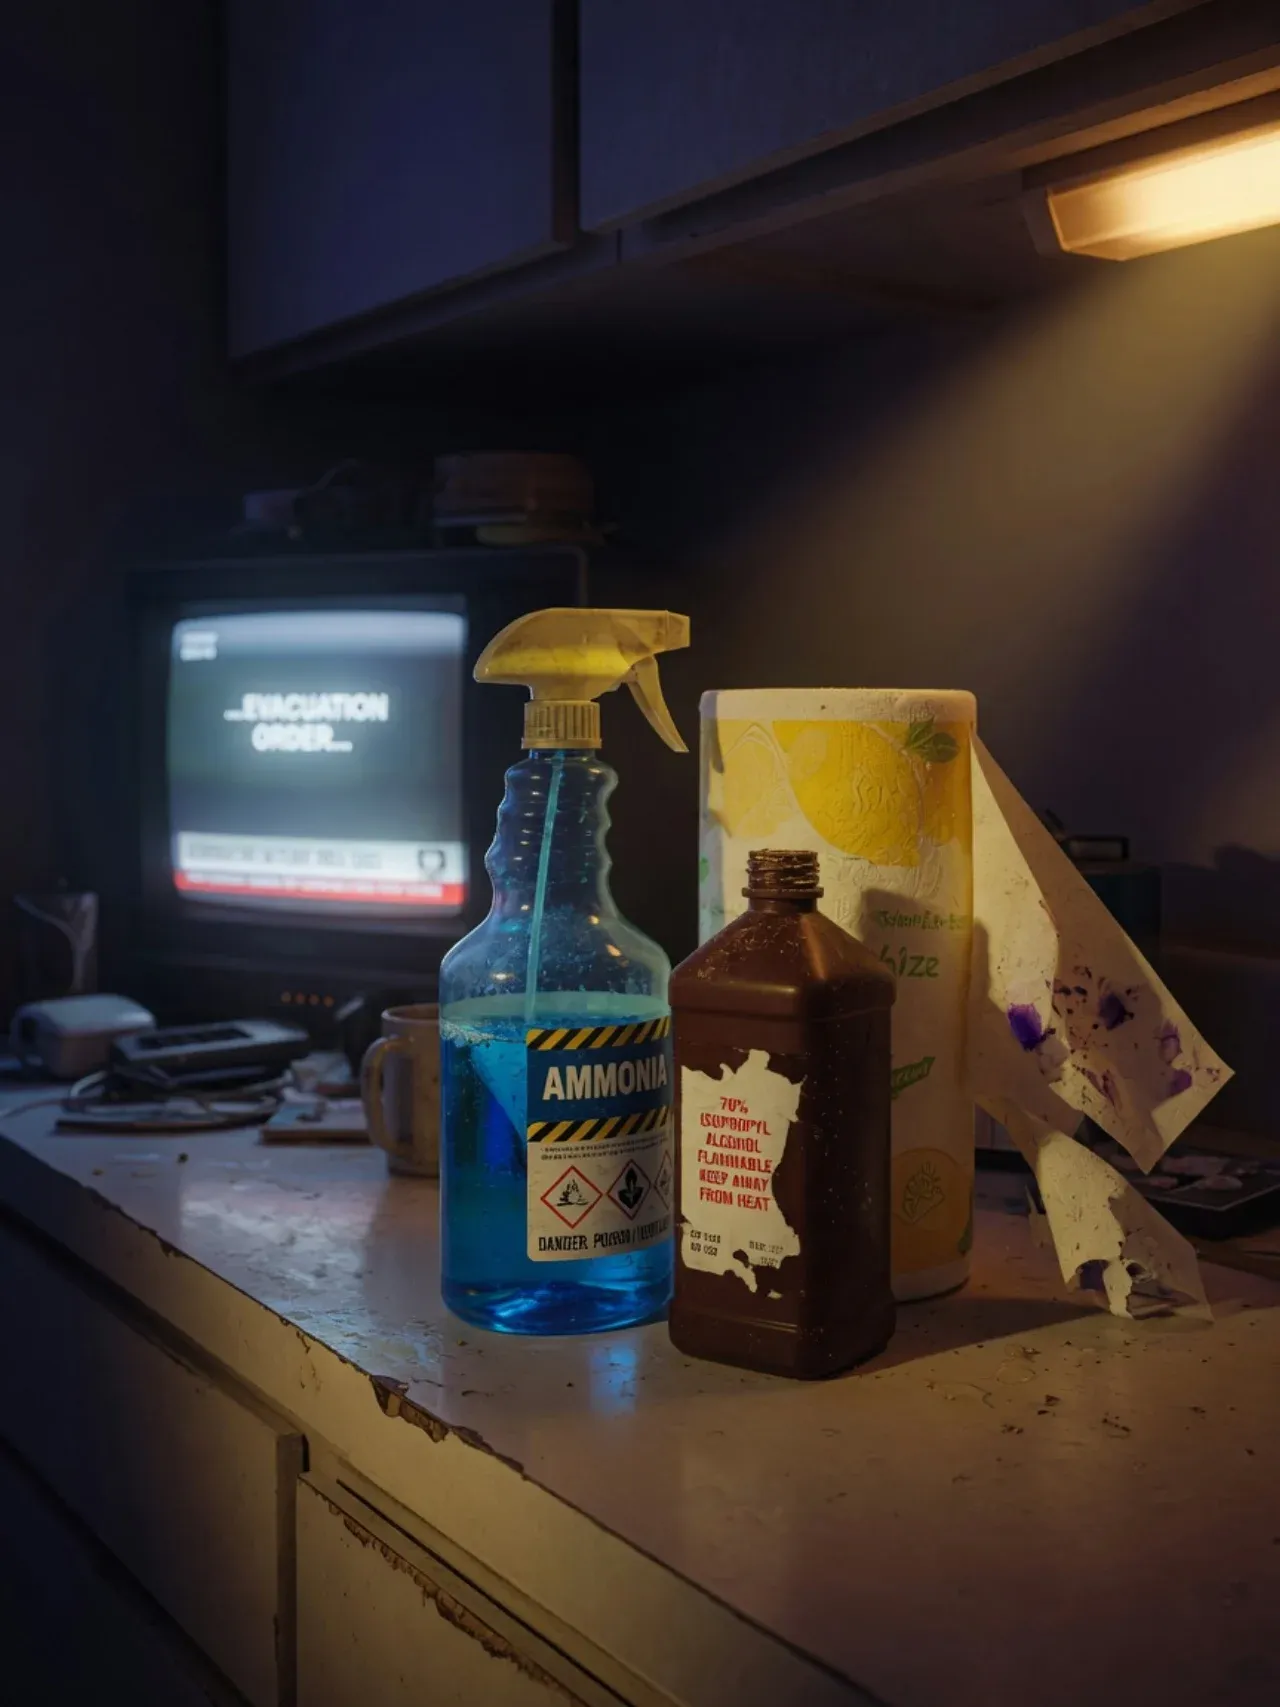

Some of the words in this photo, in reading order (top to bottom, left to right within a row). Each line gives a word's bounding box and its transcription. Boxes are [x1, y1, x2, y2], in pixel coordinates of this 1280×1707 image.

[542, 1054, 668, 1101] AMMONIA
[699, 1187, 732, 1205] FROM
[737, 1194, 770, 1212] HEAT
